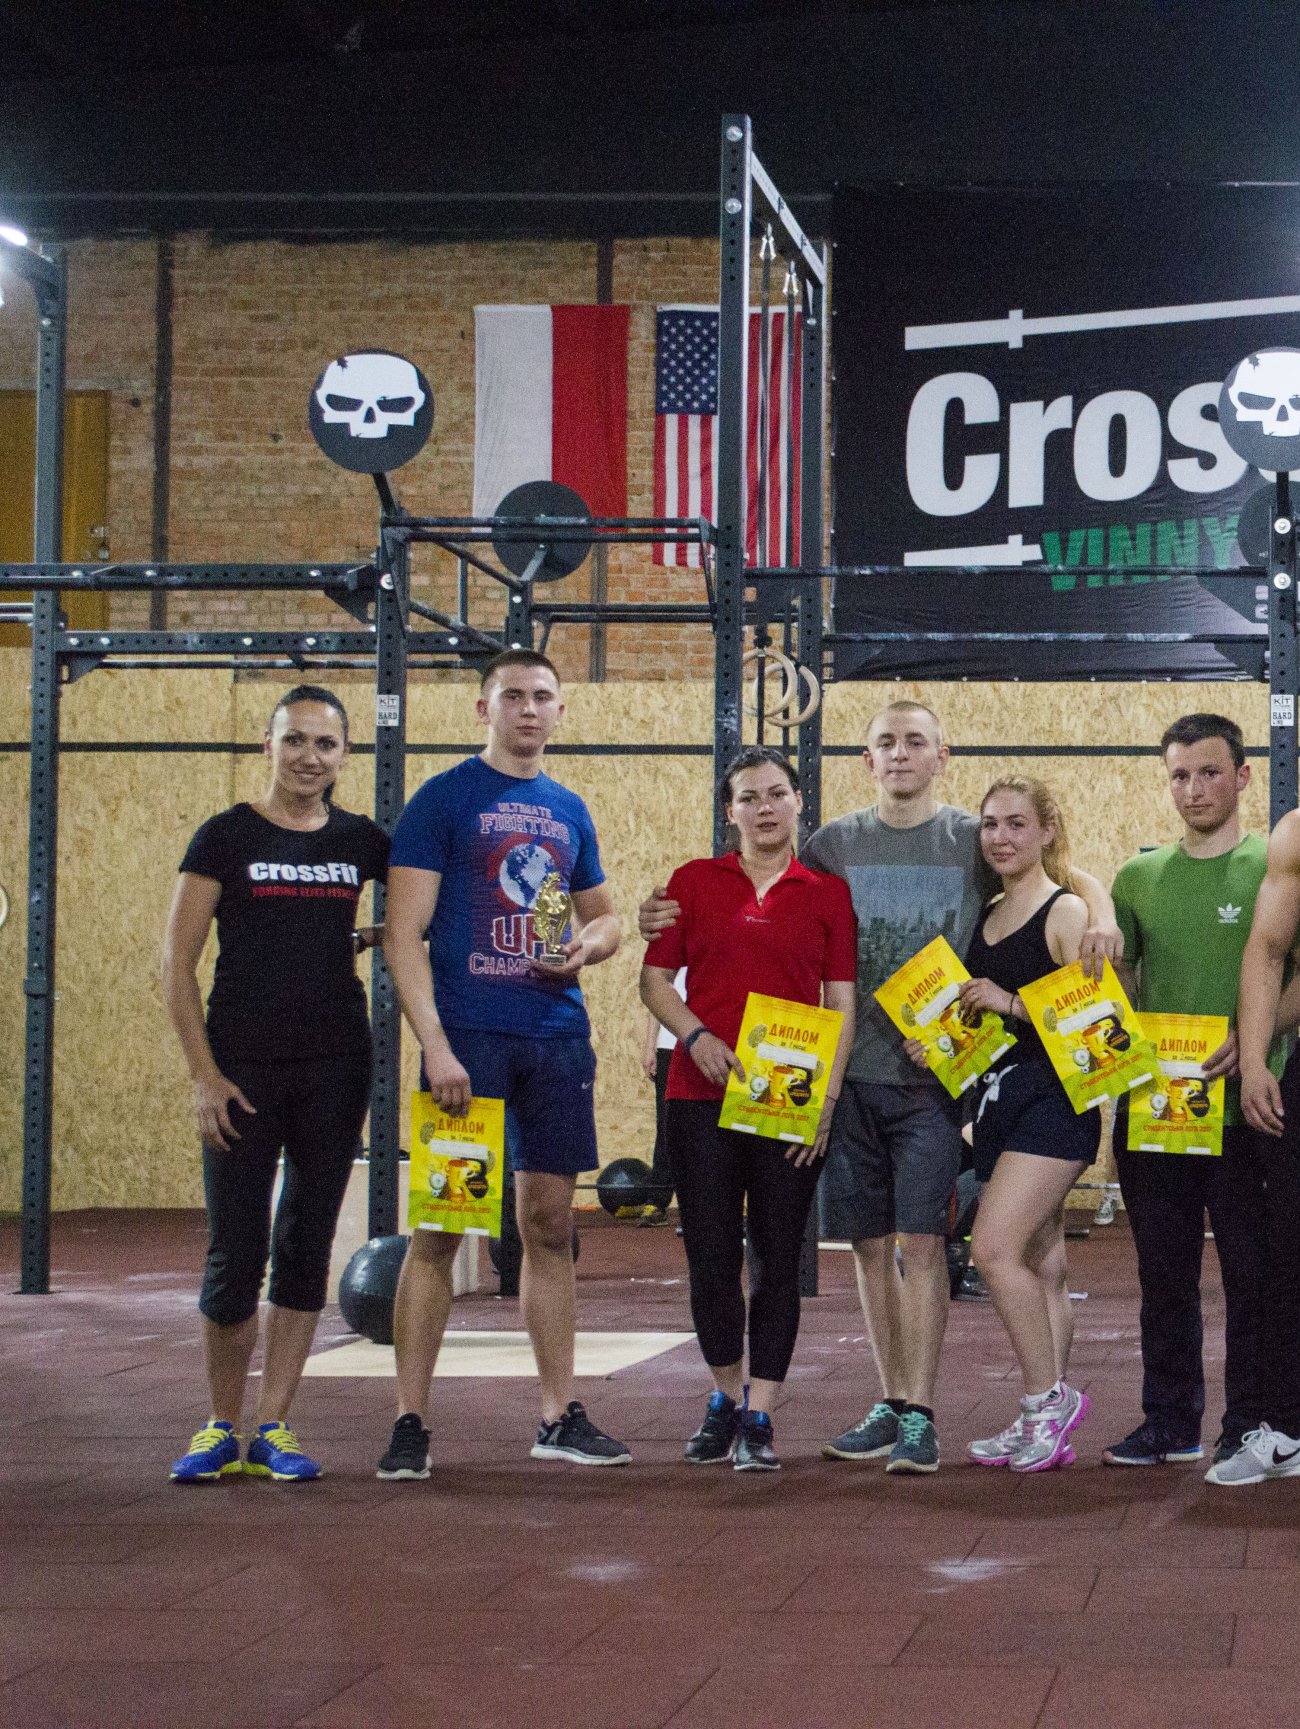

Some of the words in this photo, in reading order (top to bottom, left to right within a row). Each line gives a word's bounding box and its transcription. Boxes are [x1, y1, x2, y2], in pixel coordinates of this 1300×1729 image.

[498, 803, 552, 818] ULTIMATE
[480, 813, 570, 844] FIGHTING
[469, 952, 537, 977] CHAMP
[907, 966, 946, 1006] ДИПЛОМ
[1055, 980, 1100, 1012] ДИПЛОМ
[768, 1024, 820, 1045] ДИПЛОМ
[1160, 1038, 1207, 1054] ДИПЛОМ
[438, 1118, 484, 1134] ДИПЛОМ
